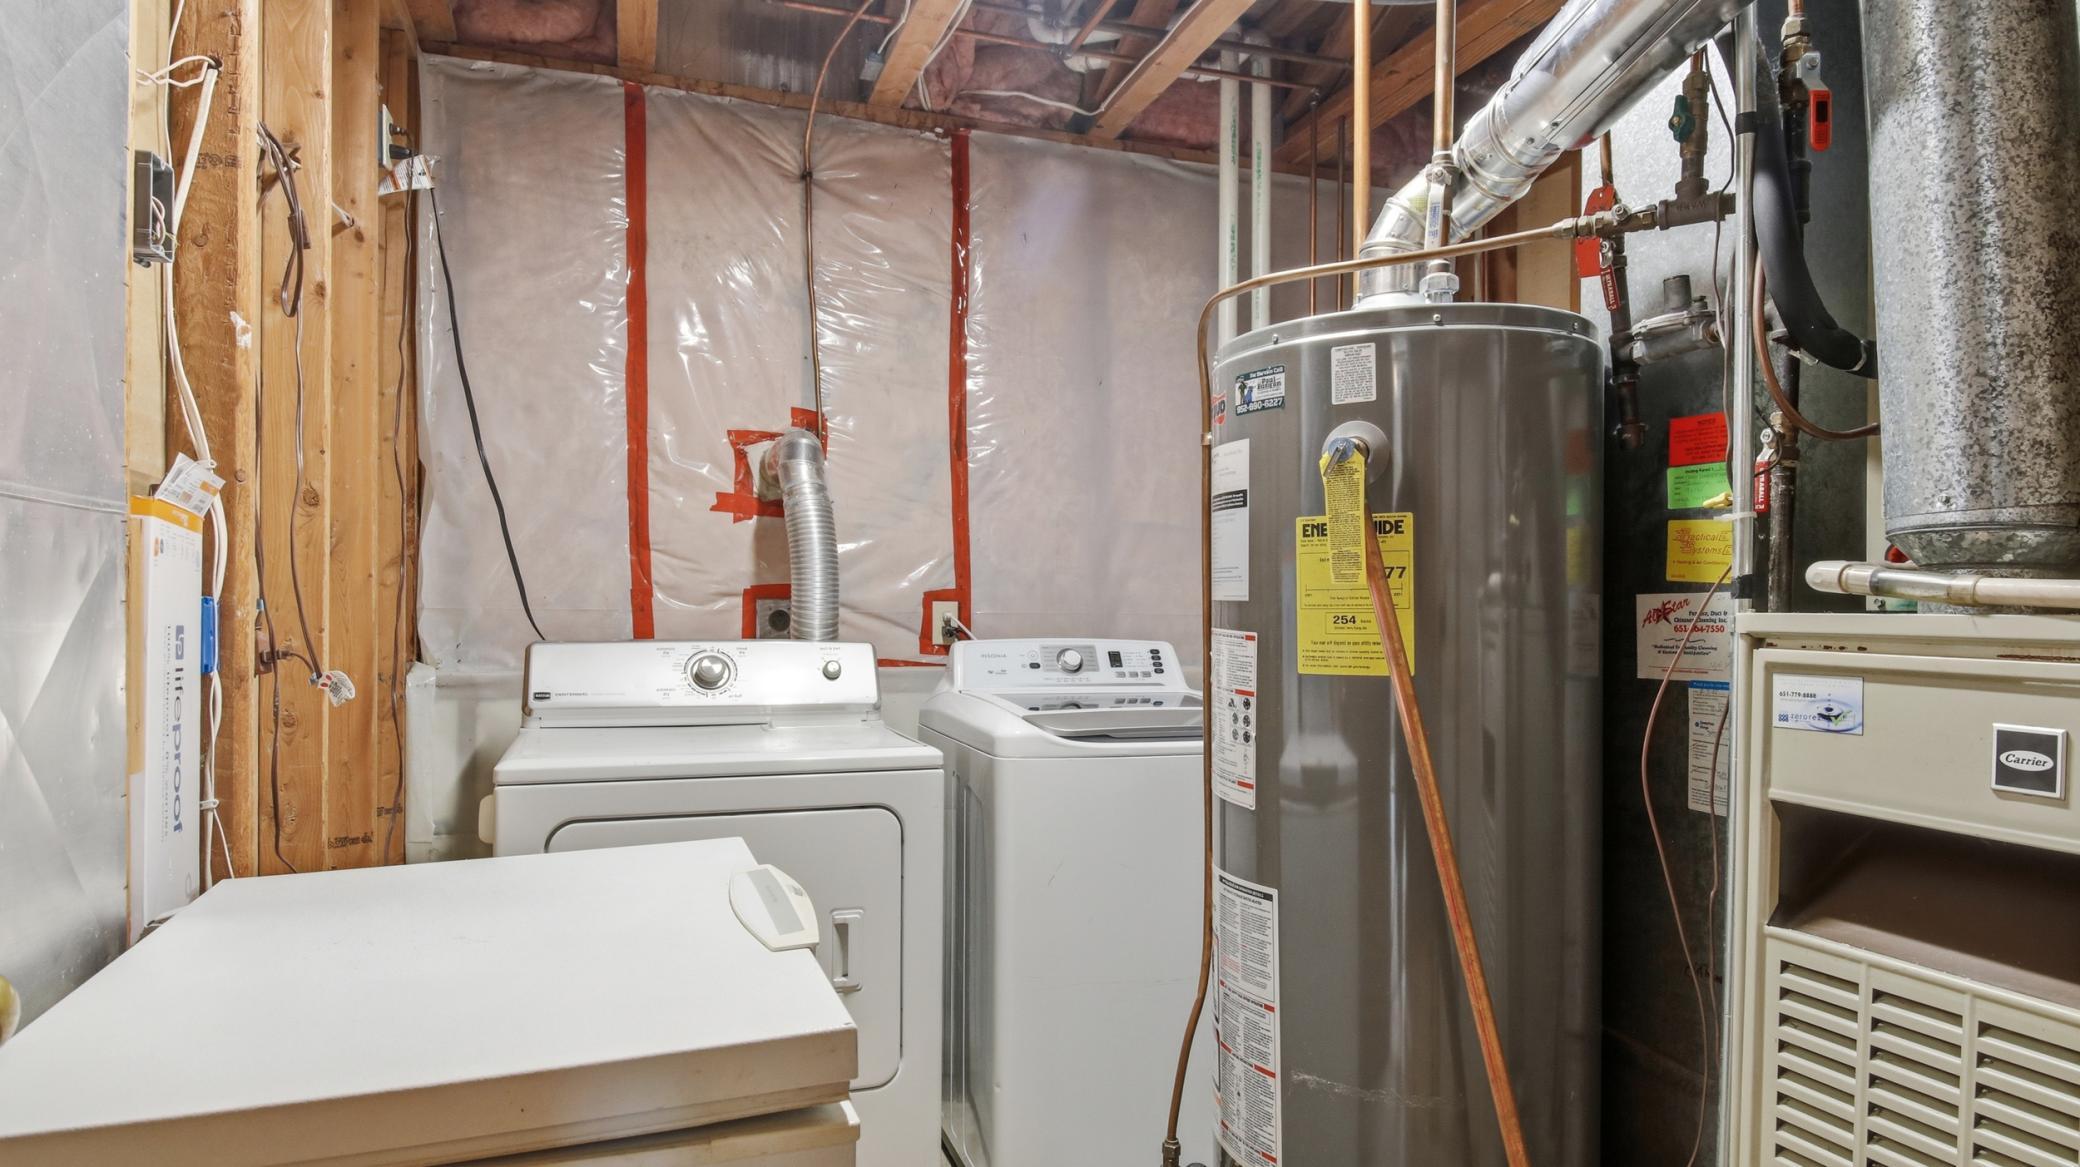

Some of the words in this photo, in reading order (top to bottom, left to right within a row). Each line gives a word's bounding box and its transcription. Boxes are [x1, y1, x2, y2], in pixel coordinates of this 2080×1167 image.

[1333, 615, 1356, 624] 254
[1674, 625, 1725, 633] 651-64-7550
[172, 667, 185, 833] lifeproof
[2005, 753, 2049, 767] Carrier
